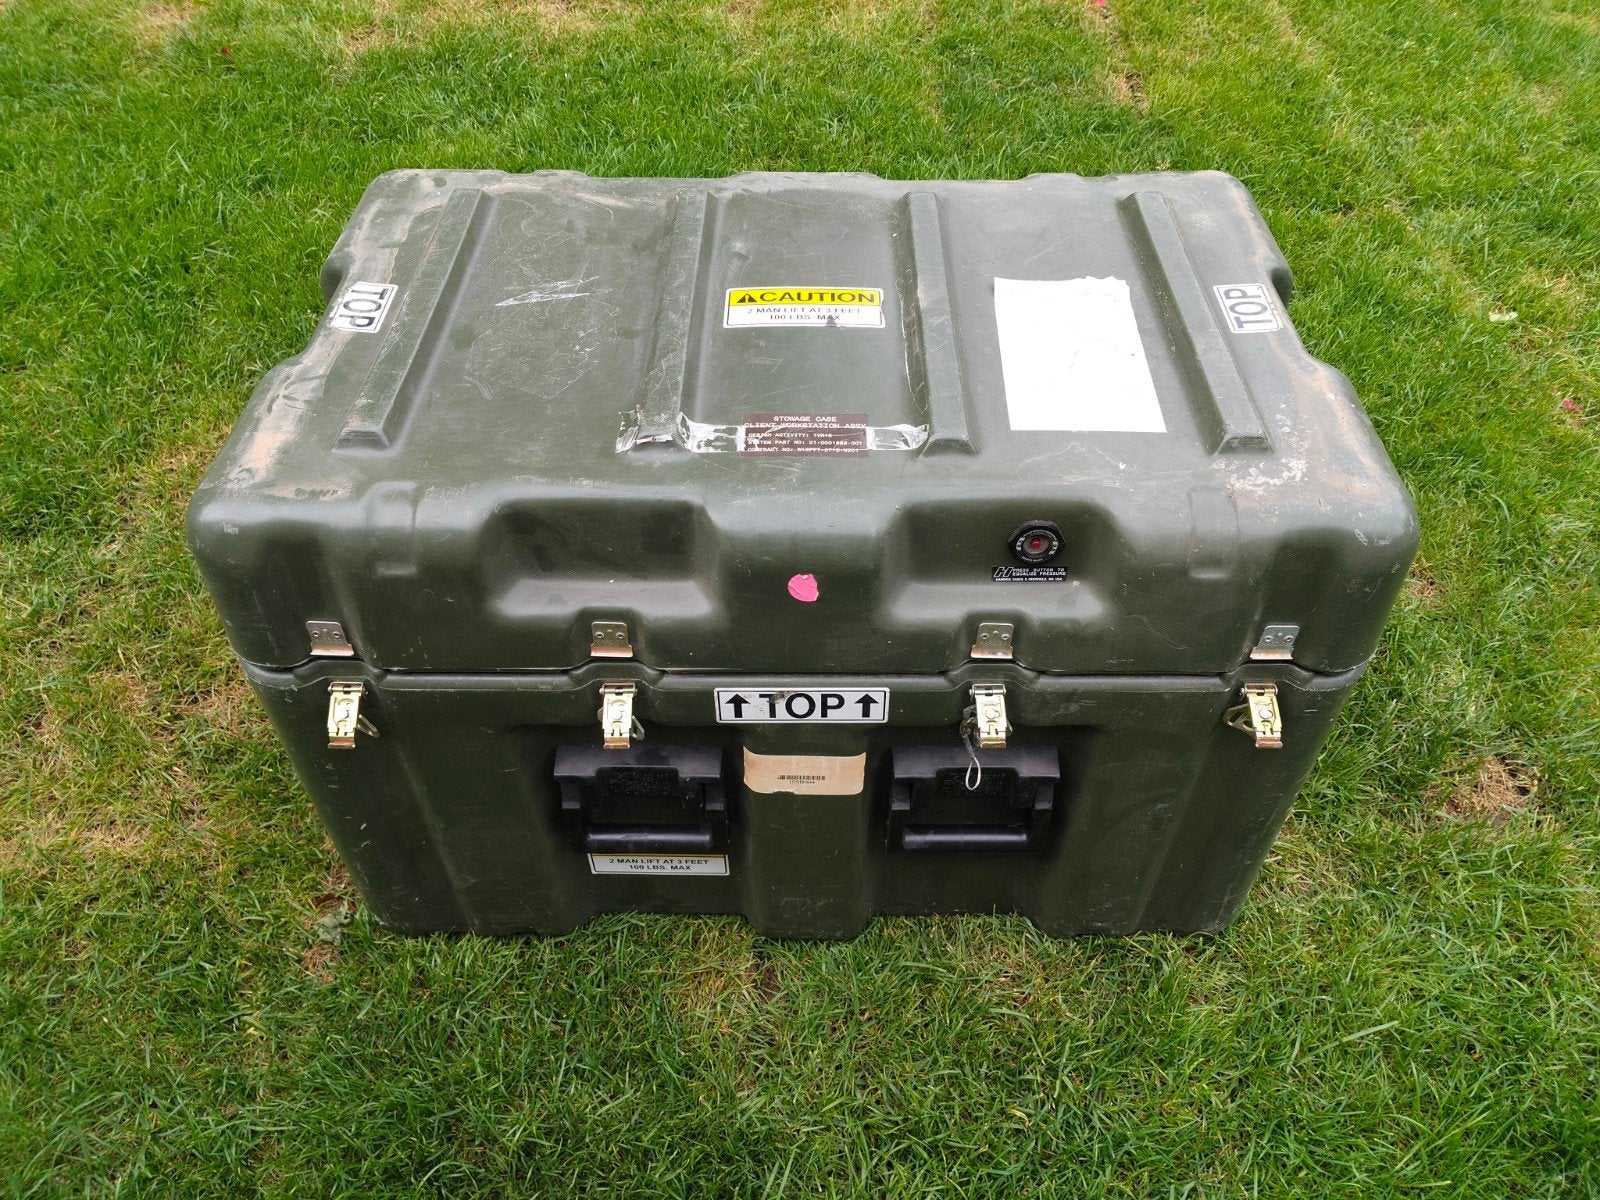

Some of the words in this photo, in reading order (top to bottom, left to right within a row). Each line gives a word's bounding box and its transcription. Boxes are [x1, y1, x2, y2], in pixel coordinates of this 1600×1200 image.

[338, 287, 389, 328] TOP
[759, 291, 875, 303] CAUTION
[1223, 288, 1273, 329] TOP
[758, 692, 846, 719] TOP
